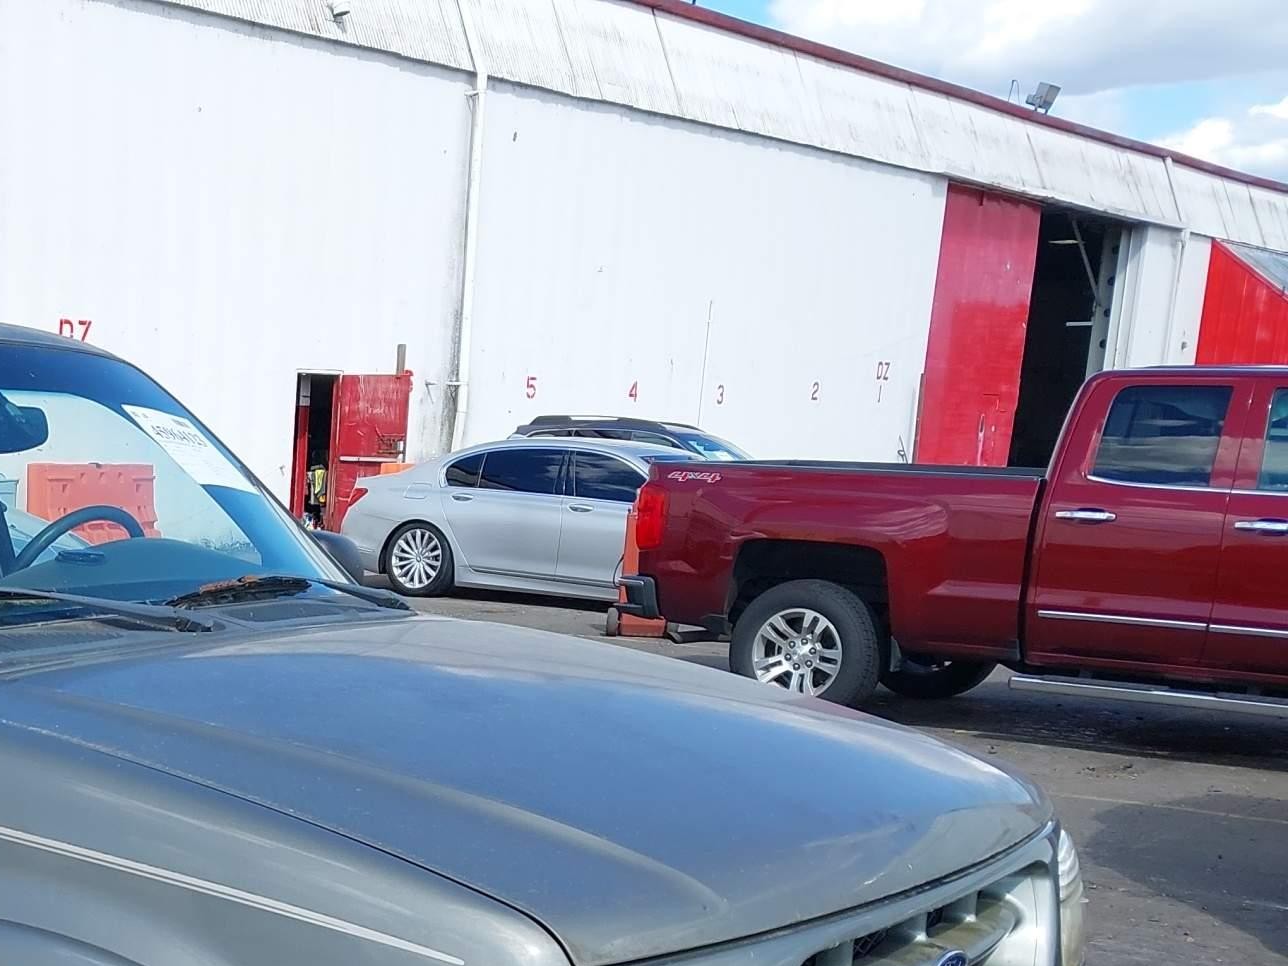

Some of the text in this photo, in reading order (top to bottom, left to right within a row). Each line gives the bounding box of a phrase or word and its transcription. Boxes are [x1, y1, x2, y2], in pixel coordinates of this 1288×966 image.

[526, 376, 537, 399] 5
[628, 381, 638, 402] 4
[716, 384, 725, 405] 3
[810, 381, 820, 401] 2
